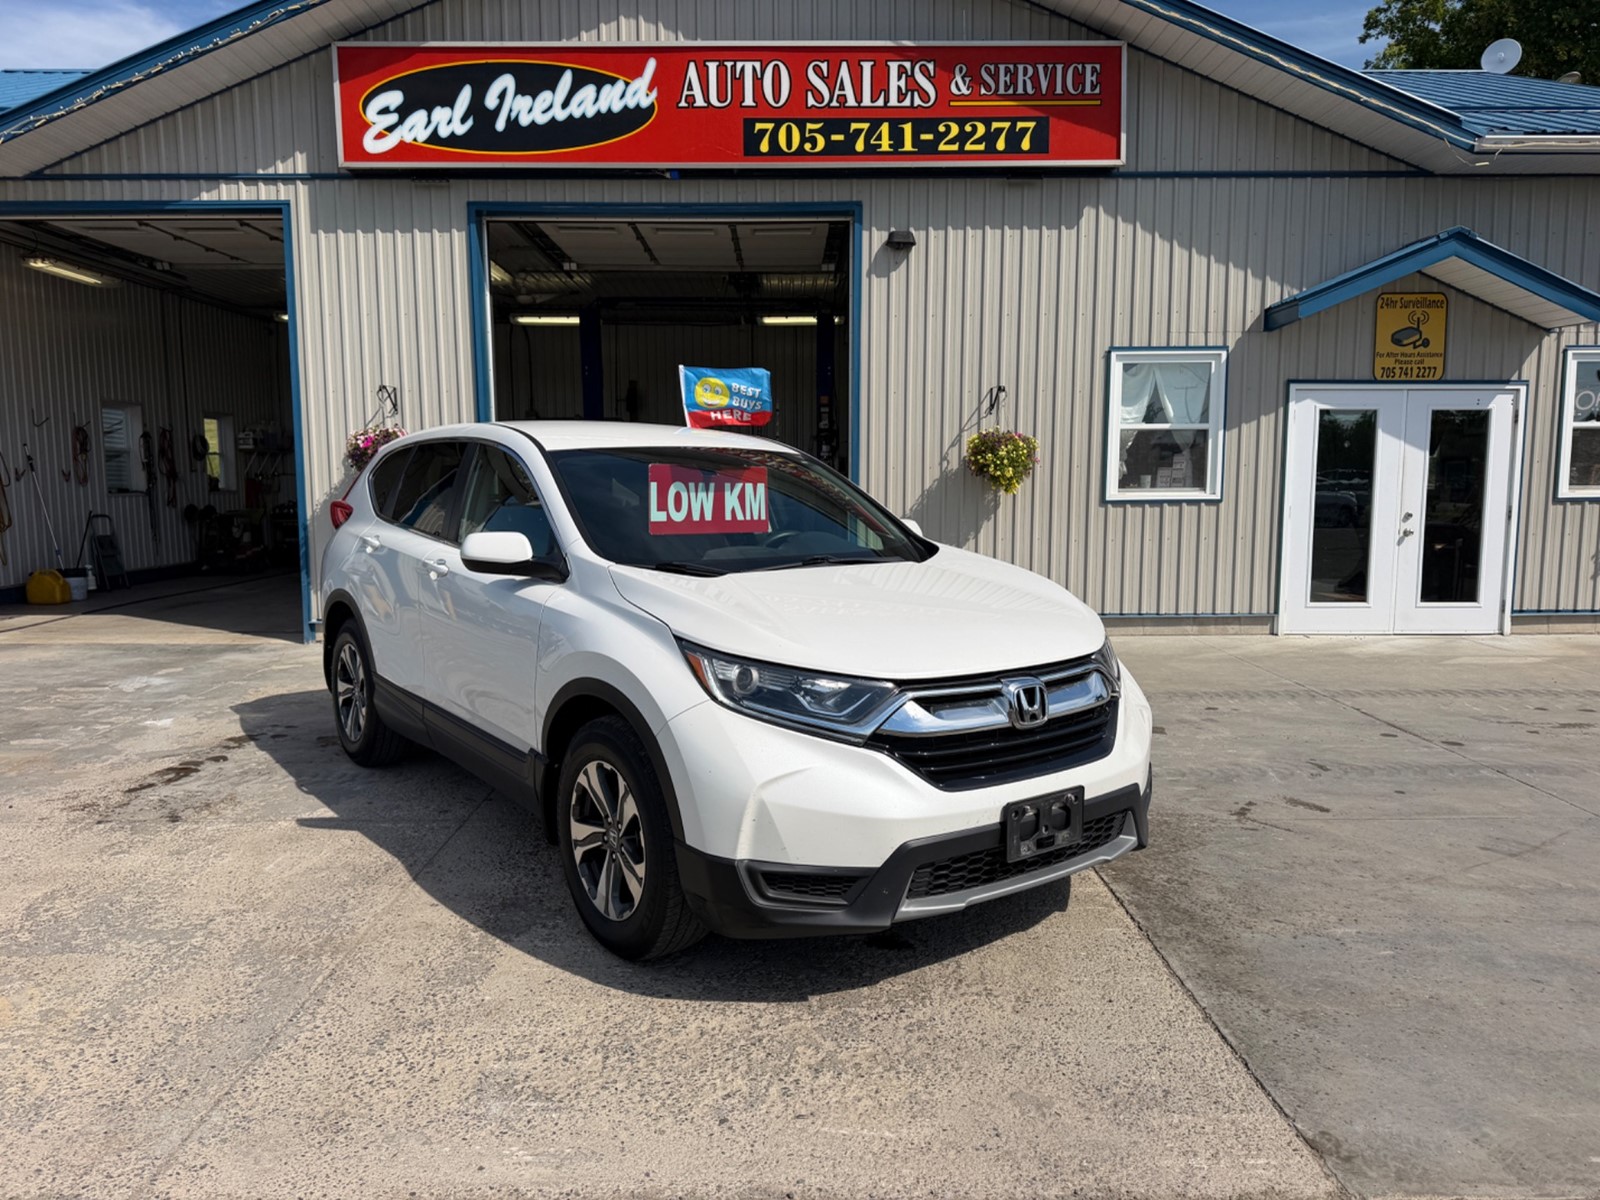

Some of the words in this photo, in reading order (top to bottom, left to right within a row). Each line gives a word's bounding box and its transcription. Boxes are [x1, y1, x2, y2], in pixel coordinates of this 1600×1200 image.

[677, 59, 792, 109] AUTO
[805, 59, 937, 109] SALES
[949, 63, 973, 97] &
[979, 62, 1101, 96] SERVICE
[362, 83, 474, 154] Earl
[484, 57, 658, 132] Ireland
[753, 120, 1037, 154] 705-741-2277
[1380, 297, 1398, 309] 24hr
[1399, 297, 1444, 309] Surveillance
[1381, 367, 1396, 378] 705
[1398, 367, 1413, 378] 741
[1416, 367, 1437, 378] 2277
[731, 382, 762, 398] BEST
[732, 397, 763, 410] BUYS
[710, 409, 752, 421] HERE
[650, 481, 715, 522] LOW
[724, 482, 766, 521] KM
